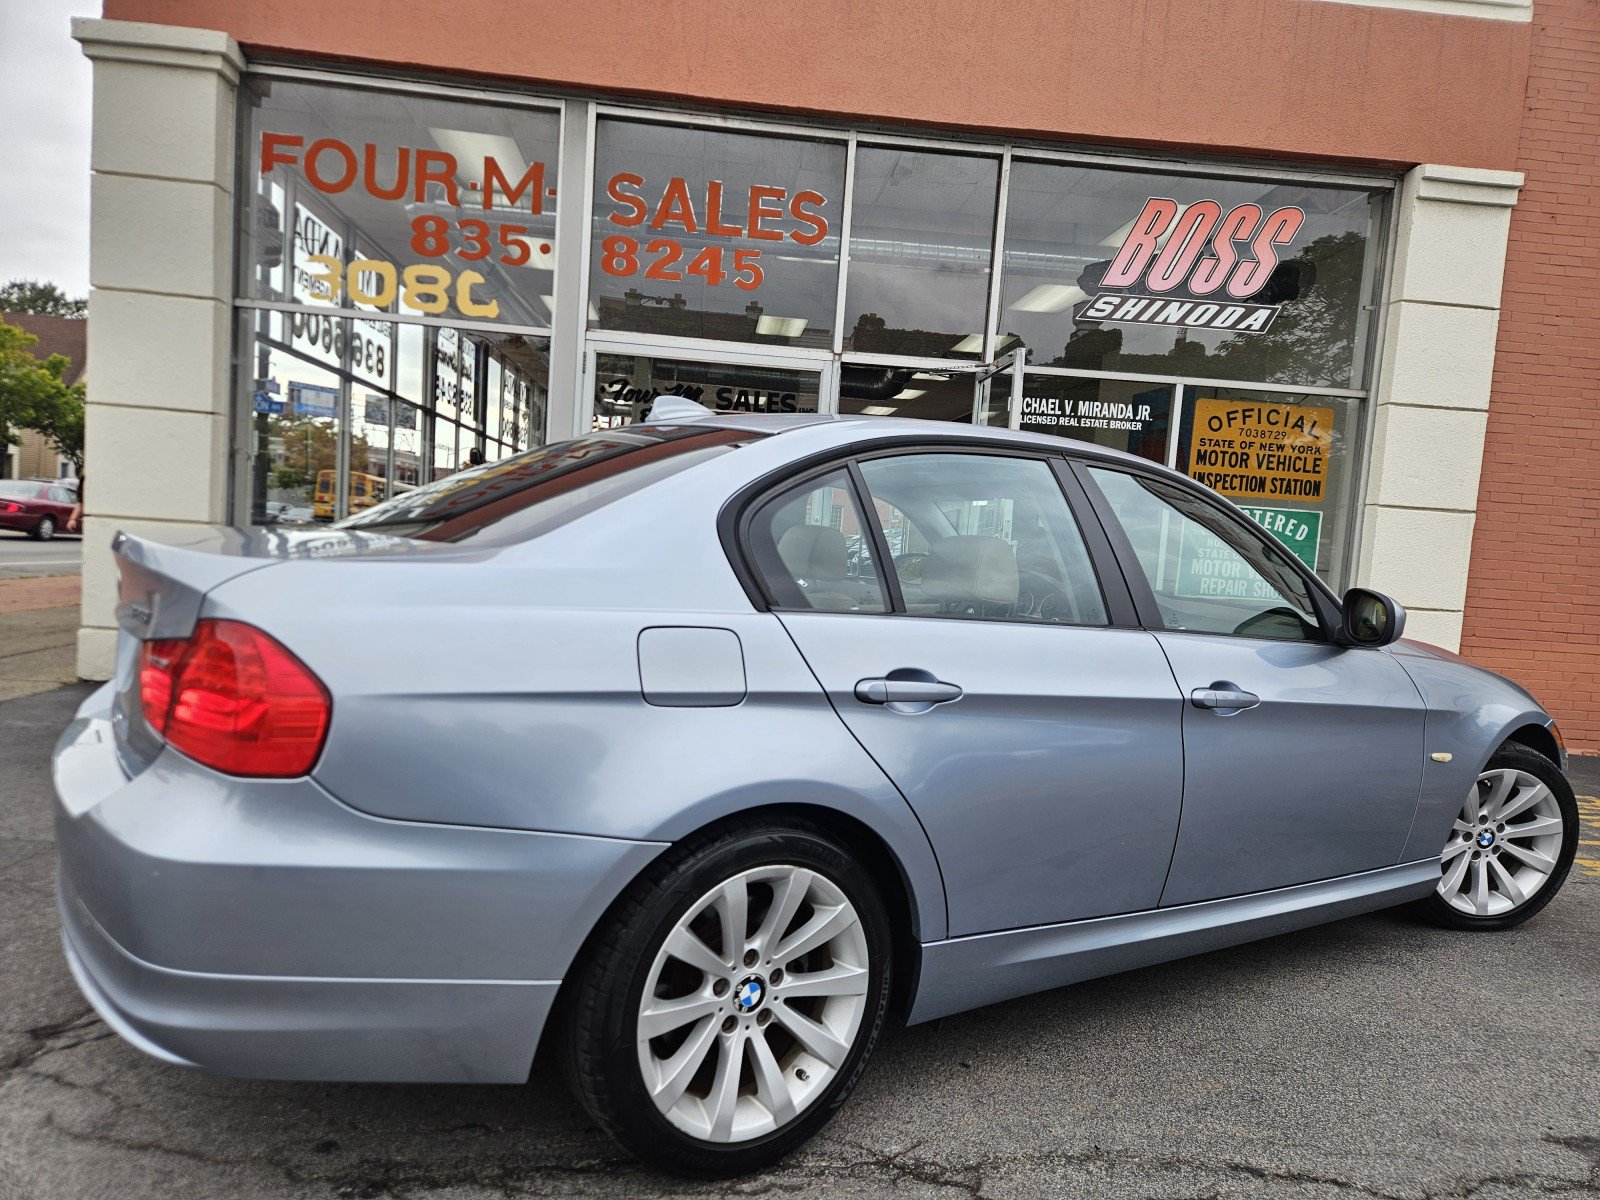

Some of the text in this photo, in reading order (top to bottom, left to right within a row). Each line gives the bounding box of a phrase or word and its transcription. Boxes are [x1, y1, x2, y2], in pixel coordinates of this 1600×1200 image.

[606, 172, 828, 246] SALES
[1098, 196, 1305, 299] BOSS
[600, 234, 765, 291] 8245
[305, 254, 499, 318] 308C
[1086, 296, 1272, 332] SHINODA
[715, 387, 797, 413] SALES
[1008, 396, 1153, 421] CHAEL V. MIRANDA JR.
[1020, 414, 1143, 431] LICENSED REAL ESTATE BROKER
[1207, 407, 1320, 440] OFFICIAL
[1238, 427, 1288, 440] 7038729
[1199, 437, 1322, 455] STATE OF NEW YORK
[1195, 448, 1323, 475] MOTOR VEHICLE
[1192, 471, 1322, 497] INSPECTION STATION
[1198, 548, 1231, 560] STATE
[1191, 559, 1241, 578] MOTOR
[1200, 577, 1248, 597] REPAIR
